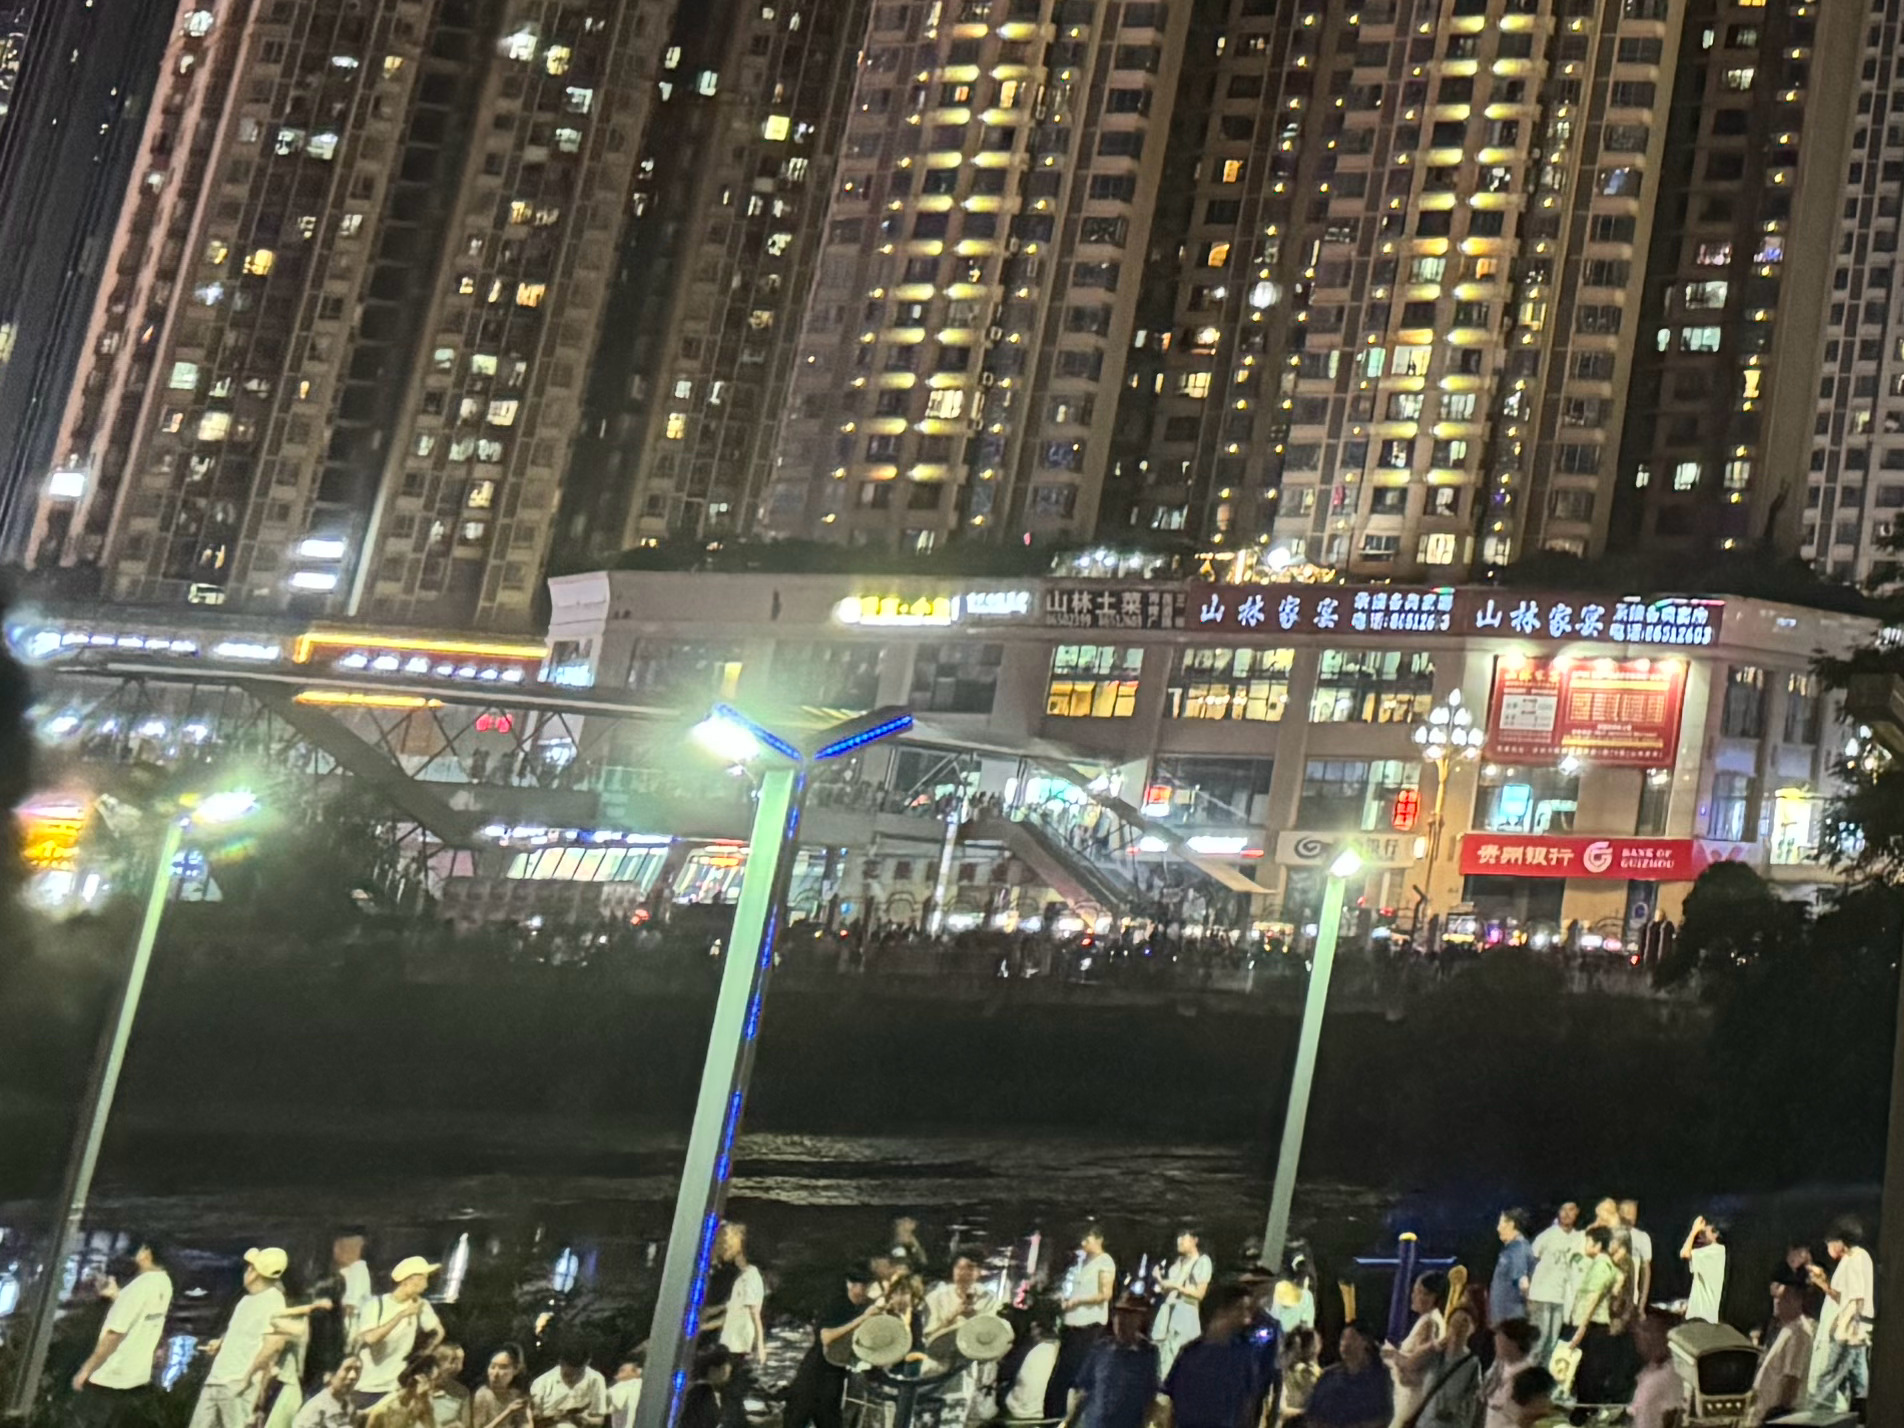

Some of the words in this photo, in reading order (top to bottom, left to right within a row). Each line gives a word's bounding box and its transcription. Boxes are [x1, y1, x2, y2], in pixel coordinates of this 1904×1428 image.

[1047, 590, 1142, 615] 山林土菜
[1200, 593, 1339, 630] 山林家宴
[1476, 599, 1605, 638] 山林家宴
[1477, 843, 1575, 867] 贵州银行
[1620, 858, 1675, 869] GUIZHOU
[1621, 848, 1654, 858] BANK
[1656, 848, 1673, 858] OF
